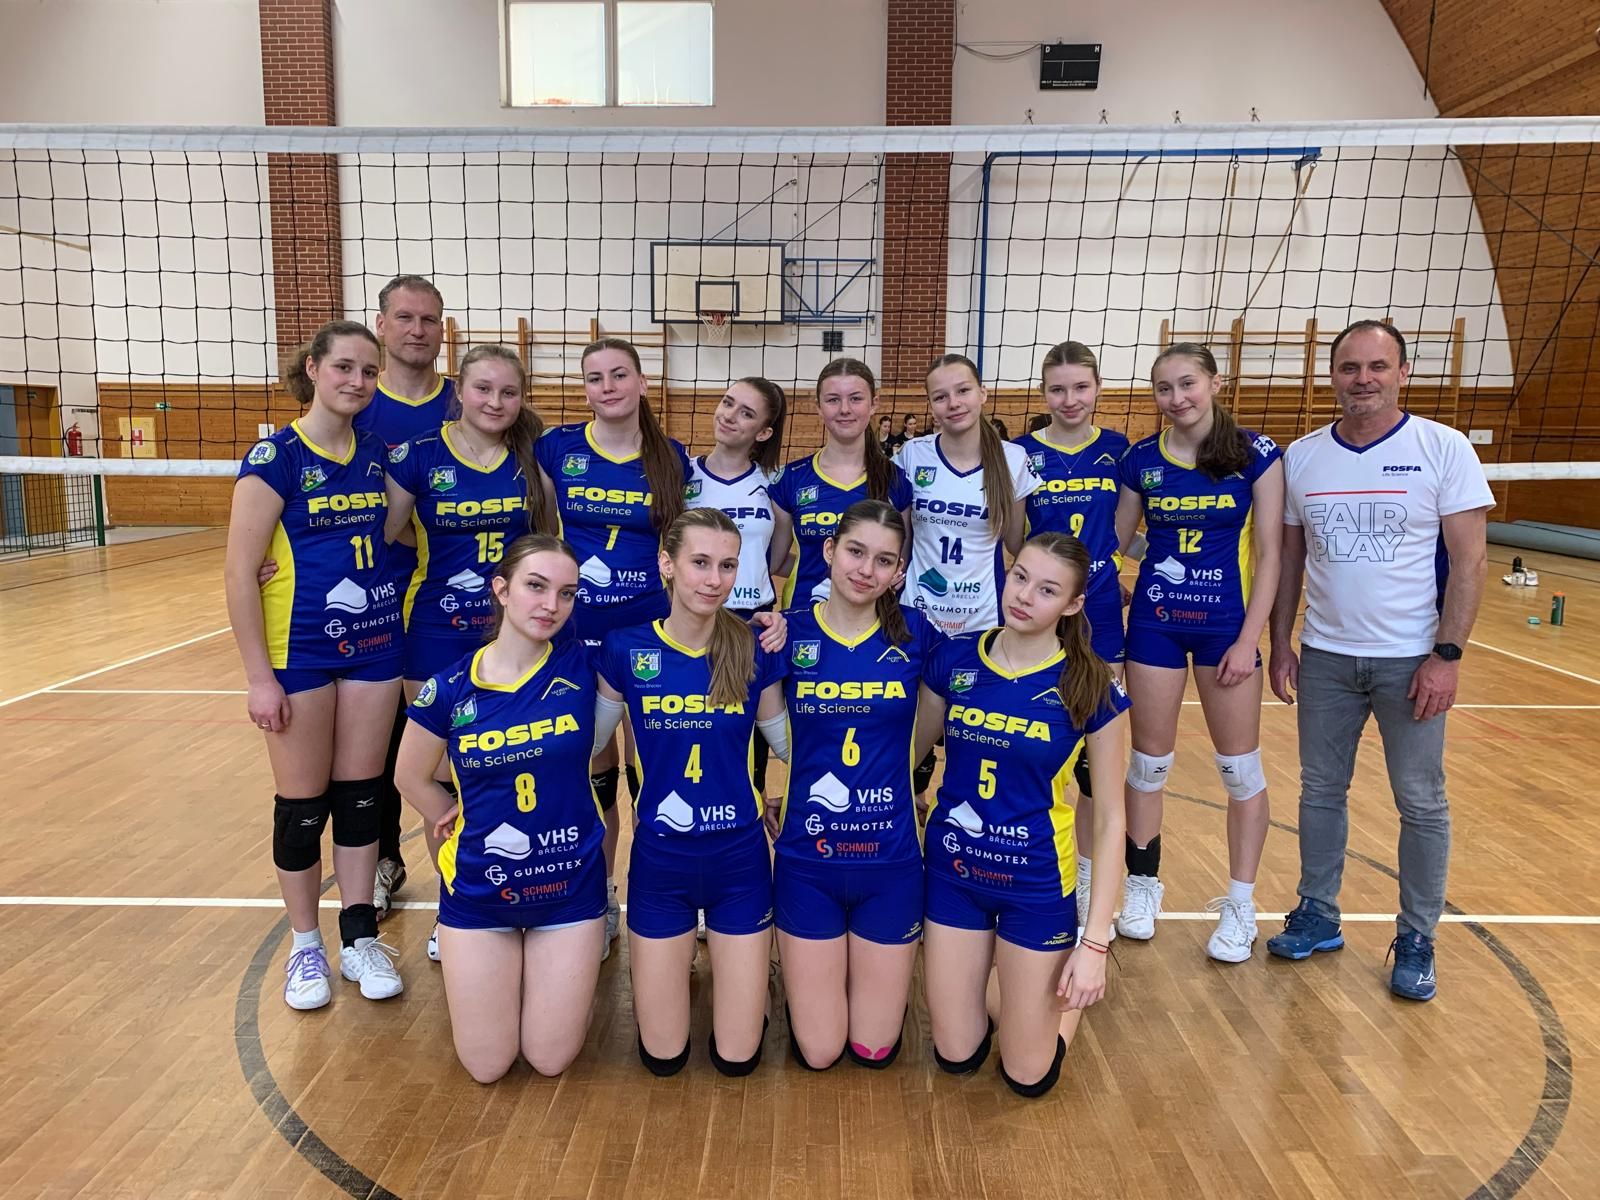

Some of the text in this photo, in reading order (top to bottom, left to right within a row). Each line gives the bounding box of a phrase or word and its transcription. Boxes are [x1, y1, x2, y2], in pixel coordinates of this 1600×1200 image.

[566, 501, 632, 516] Life Science
[1033, 494, 1092, 507] Life Science
[1148, 494, 1237, 511] FOSFA
[309, 514, 376, 527] Life Science
[435, 517, 511, 528] Life Science
[720, 507, 771, 520] SFA
[929, 516, 968, 528] Science
[1163, 514, 1206, 522] Science
[1304, 502, 1408, 534] FAIR
[1070, 513, 1085, 538] 9
[605, 524, 621, 551] 7
[1177, 528, 1203, 554] 12
[350, 535, 374, 569] 11
[474, 532, 505, 563] 15
[939, 536, 963, 564] 14
[1312, 534, 1405, 562] PLAY
[617, 570, 647, 582] VHS
[1191, 569, 1223, 581] VHS
[370, 582, 396, 601] VHS
[733, 587, 761, 599] VHS
[953, 582, 981, 593] VHS
[1168, 592, 1221, 603] GUMOTEX
[931, 604, 980, 615] GUMOTEX
[1171, 609, 1209, 620] SCHMIDT
[352, 611, 400, 630] GUMOTEX
[357, 632, 392, 649] SCHMIDT
[796, 681, 907, 700] FOSFA
[795, 702, 871, 714] Life Science
[644, 718, 713, 730] Life Science
[948, 704, 1051, 742] FOSFA
[458, 713, 580, 753] FOSFA
[946, 725, 1010, 749] Life Science
[841, 727, 861, 767] 6
[460, 746, 543, 769] Life Science
[684, 744, 703, 784] 4
[978, 758, 998, 800] 5
[515, 772, 537, 813] 8
[856, 787, 894, 805] VHS
[700, 804, 737, 823] VHS
[830, 820, 894, 832] GUMOTEX
[988, 823, 1030, 840] VHS
[537, 826, 579, 847] VHS
[836, 842, 881, 853] SCHMIDT
[965, 845, 1029, 865] GUMOTEX
[514, 859, 582, 878] GUMOTEX
[971, 865, 1014, 881] SCHMIDT
[522, 879, 569, 897] SCHMIDT
